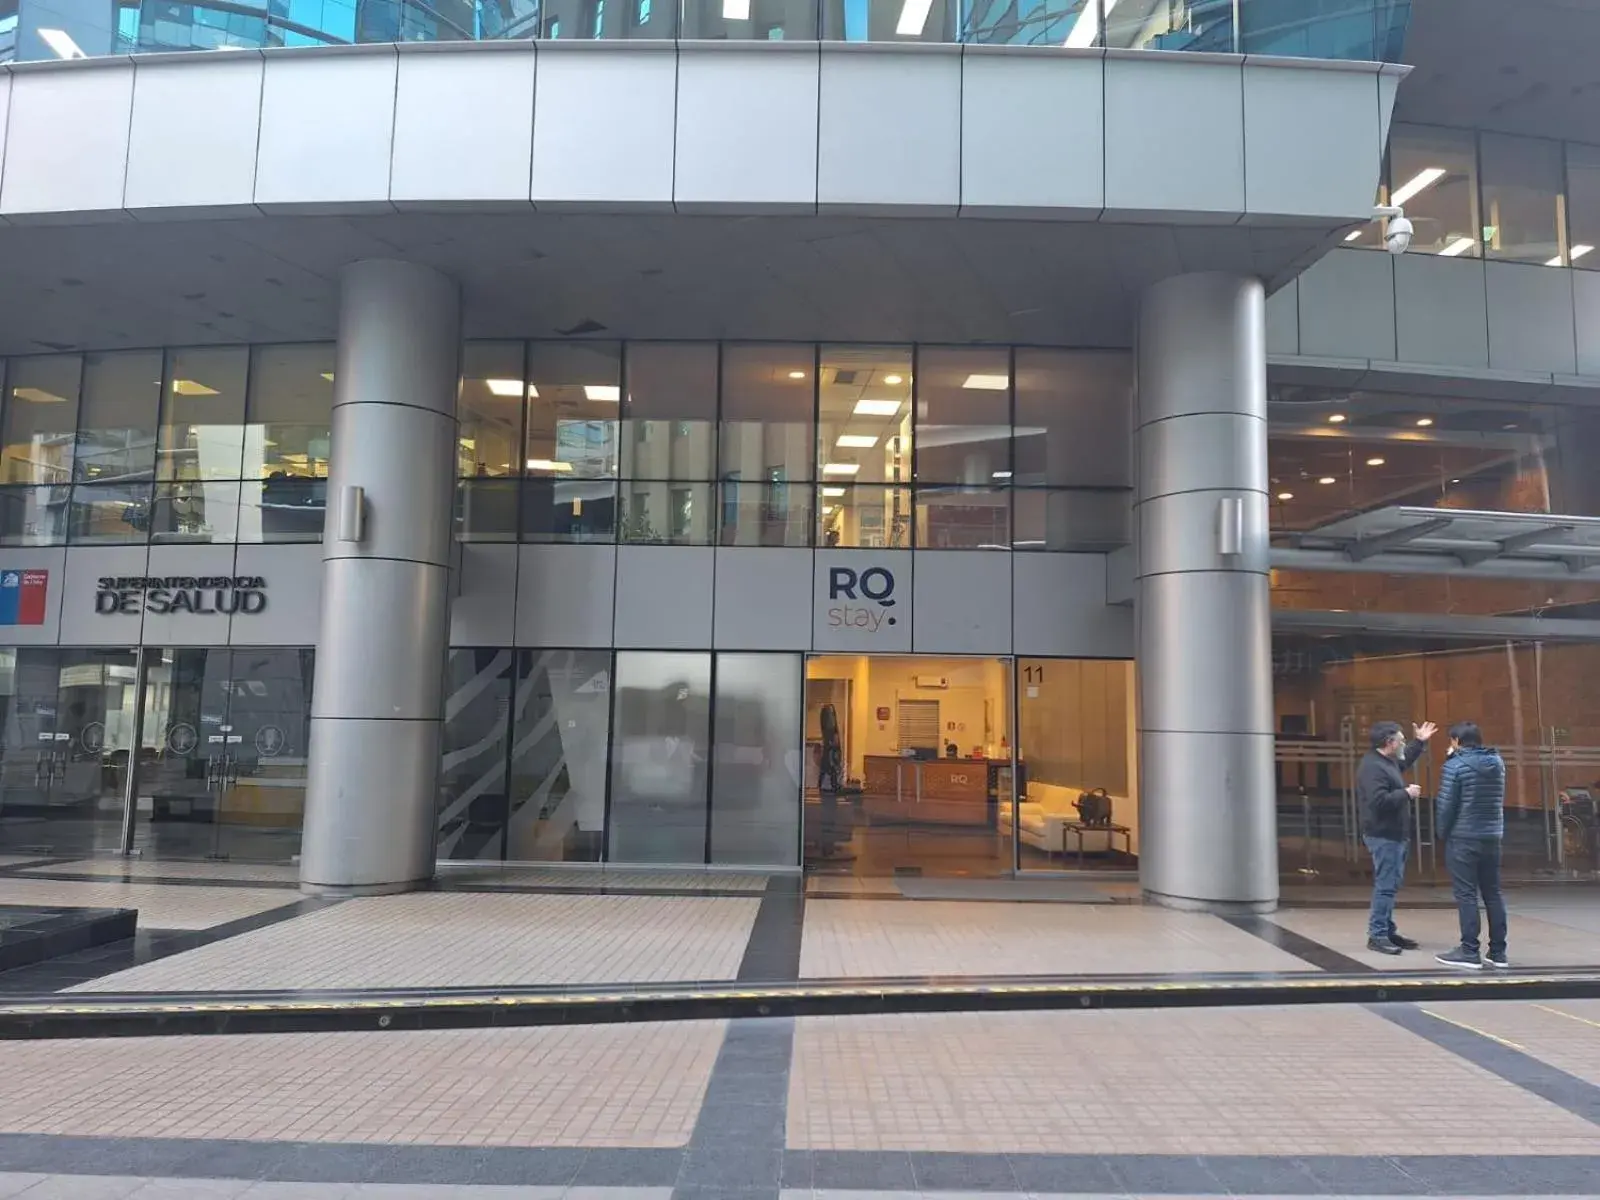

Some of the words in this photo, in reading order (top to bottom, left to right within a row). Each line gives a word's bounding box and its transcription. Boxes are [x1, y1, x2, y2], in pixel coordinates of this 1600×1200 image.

[97, 577, 266, 589] SUPERINTENDENCIA
[829, 566, 896, 607] RQ
[95, 590, 141, 614] DE
[146, 590, 267, 614] SALUD
[1024, 665, 1043, 683] 11
[950, 774, 968, 785] RQ
